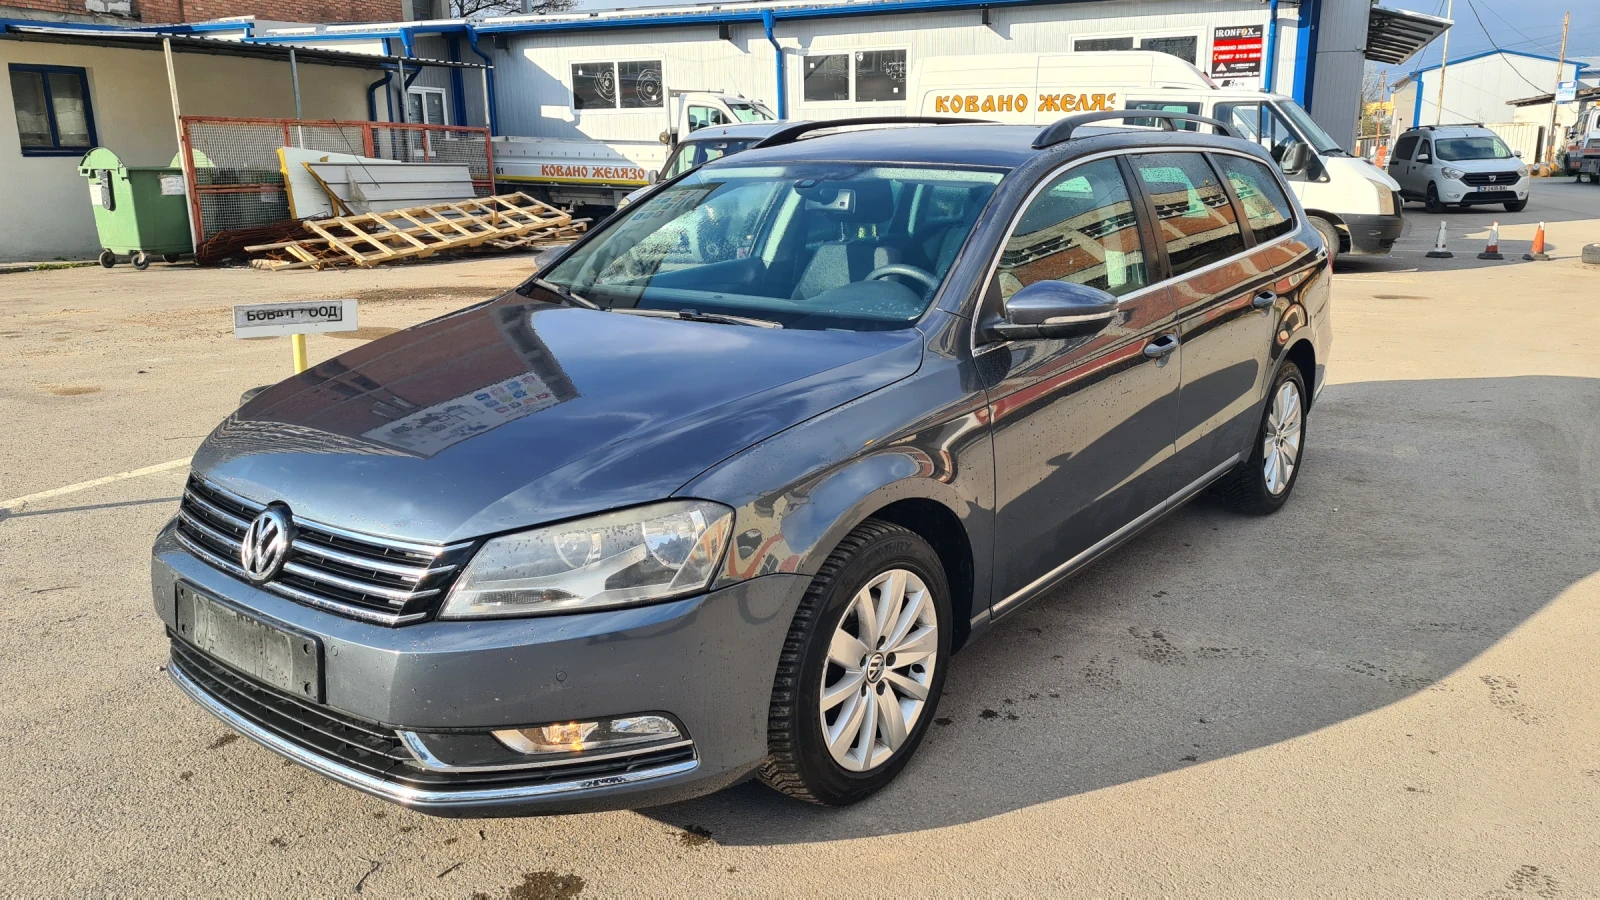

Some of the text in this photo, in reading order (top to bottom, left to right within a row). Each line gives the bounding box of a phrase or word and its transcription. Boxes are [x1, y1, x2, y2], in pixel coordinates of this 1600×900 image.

[935, 93, 1029, 113] КОВАНО
[541, 164, 645, 180] КОВАНО ЖЕЛЯЗО
